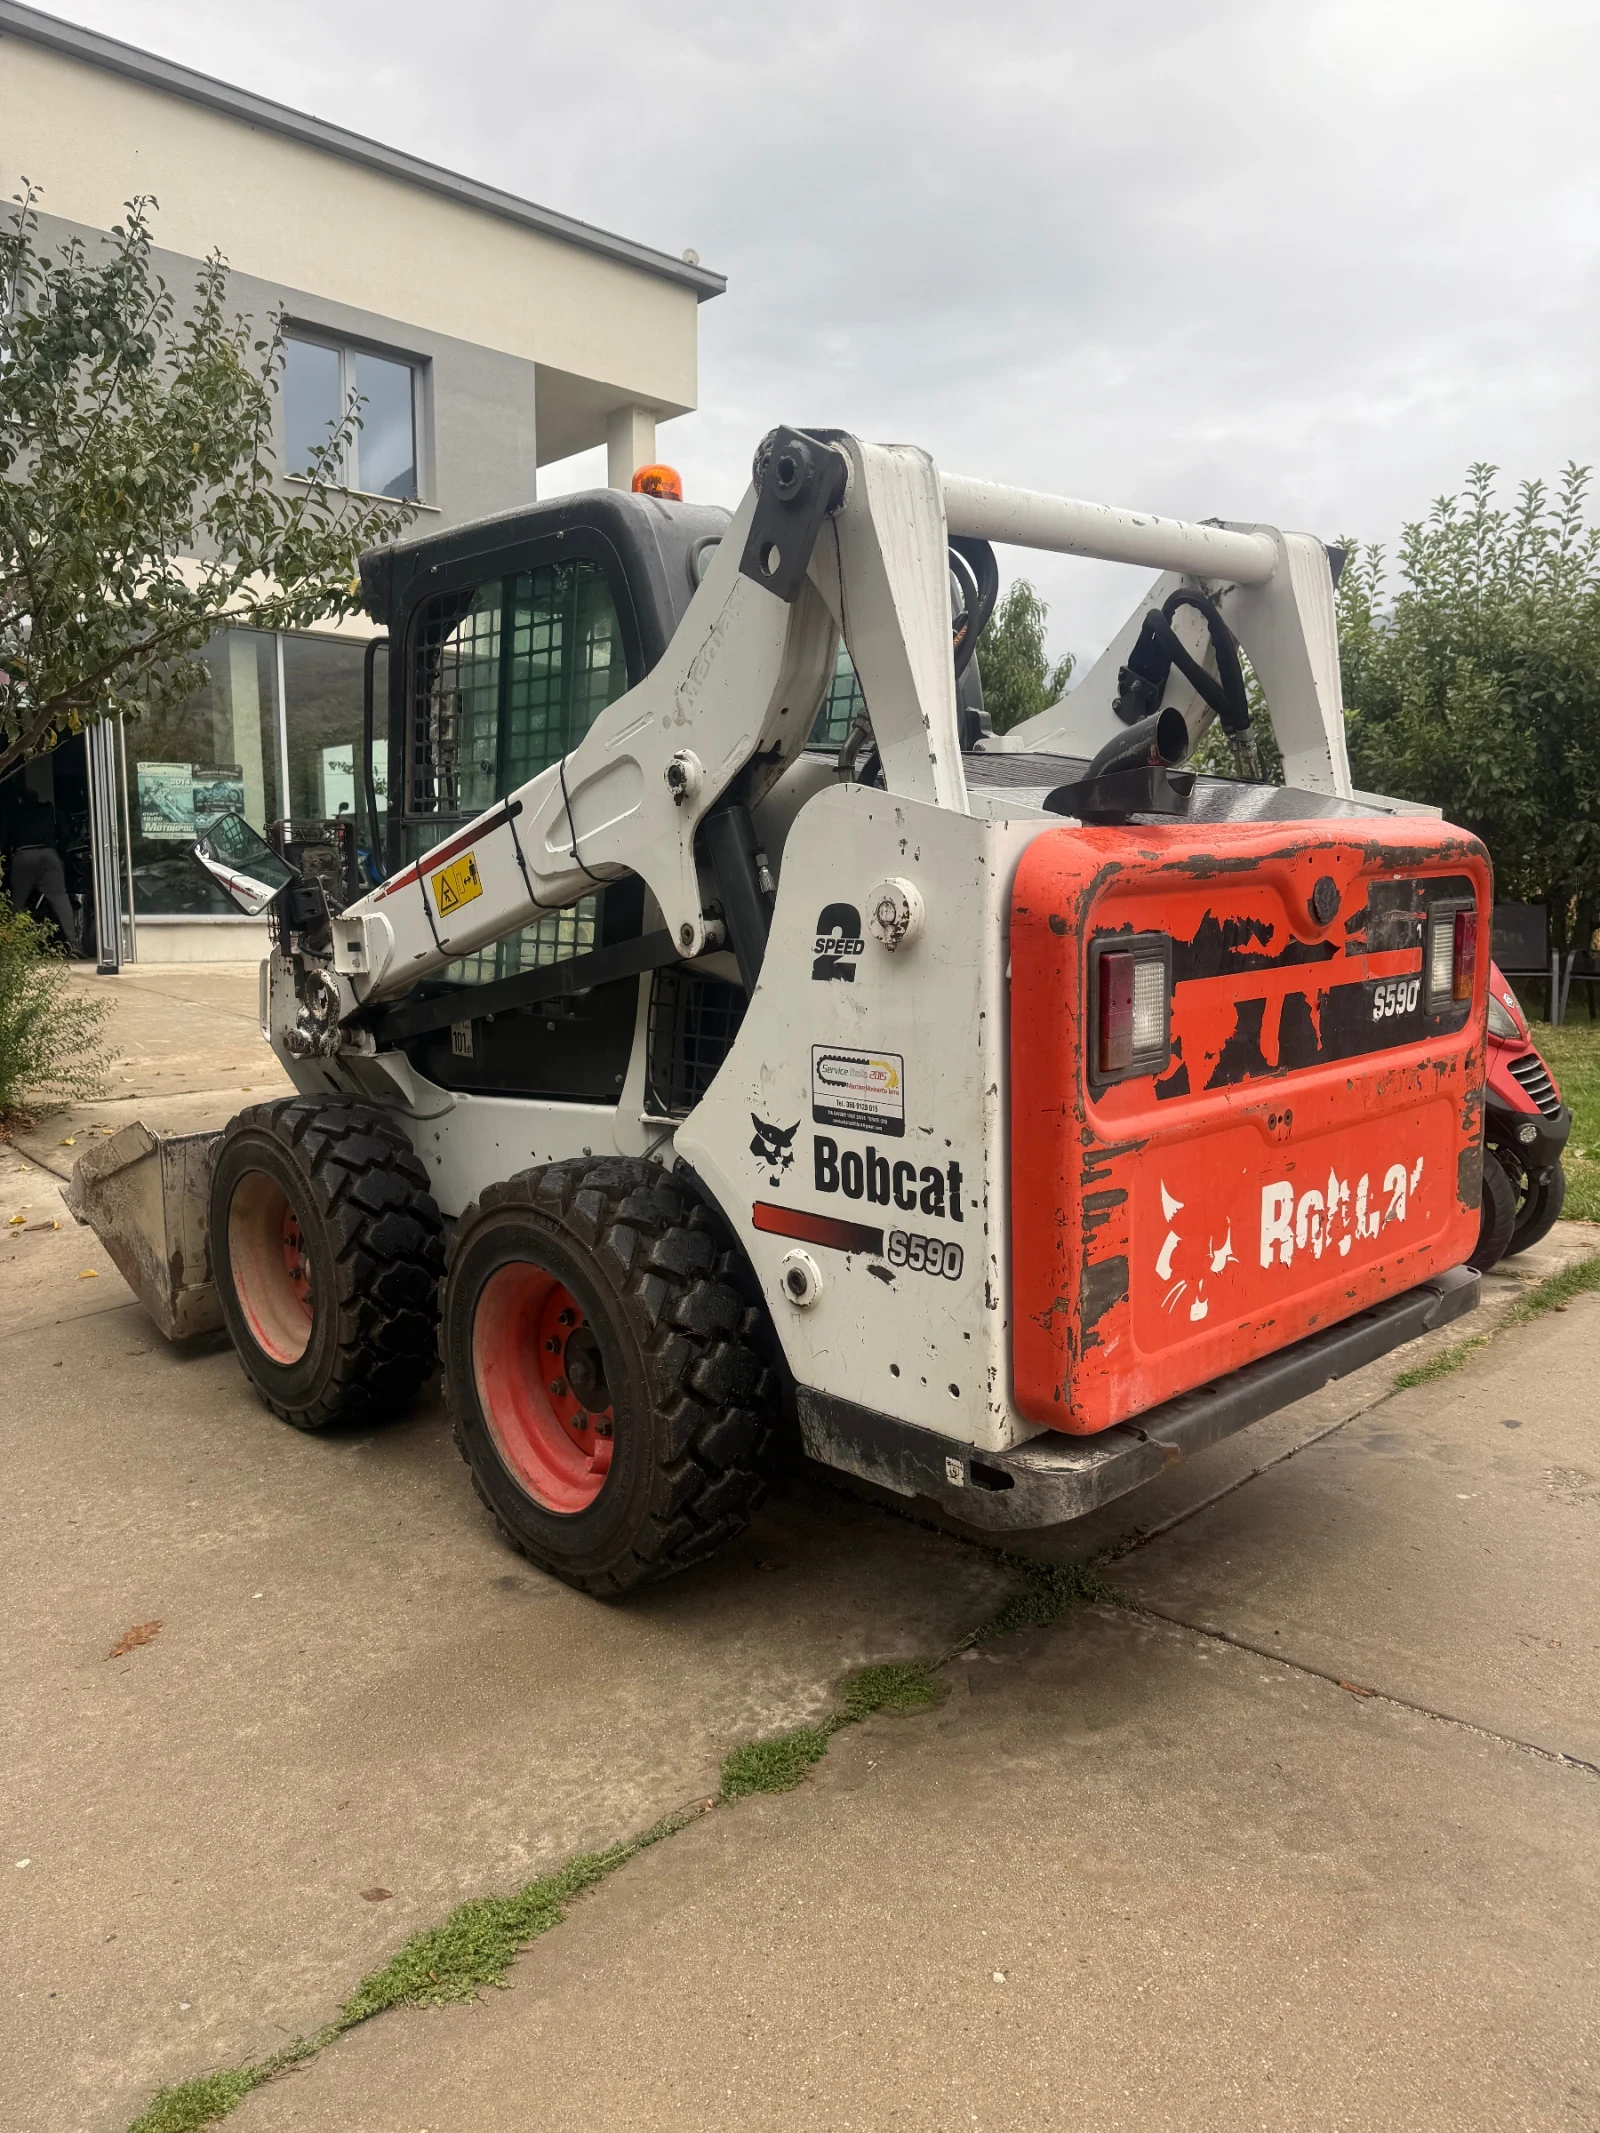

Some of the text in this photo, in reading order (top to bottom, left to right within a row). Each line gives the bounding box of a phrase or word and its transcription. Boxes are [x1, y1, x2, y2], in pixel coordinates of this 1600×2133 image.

[814, 938, 865, 956] SPEED
[1372, 979, 1421, 1022] S590
[453, 1031, 467, 1053] 101
[822, 1064, 848, 1076] Service
[869, 1070, 887, 1080] 2015
[814, 1135, 964, 1223] Bobcat
[888, 1230, 964, 1281] S590
